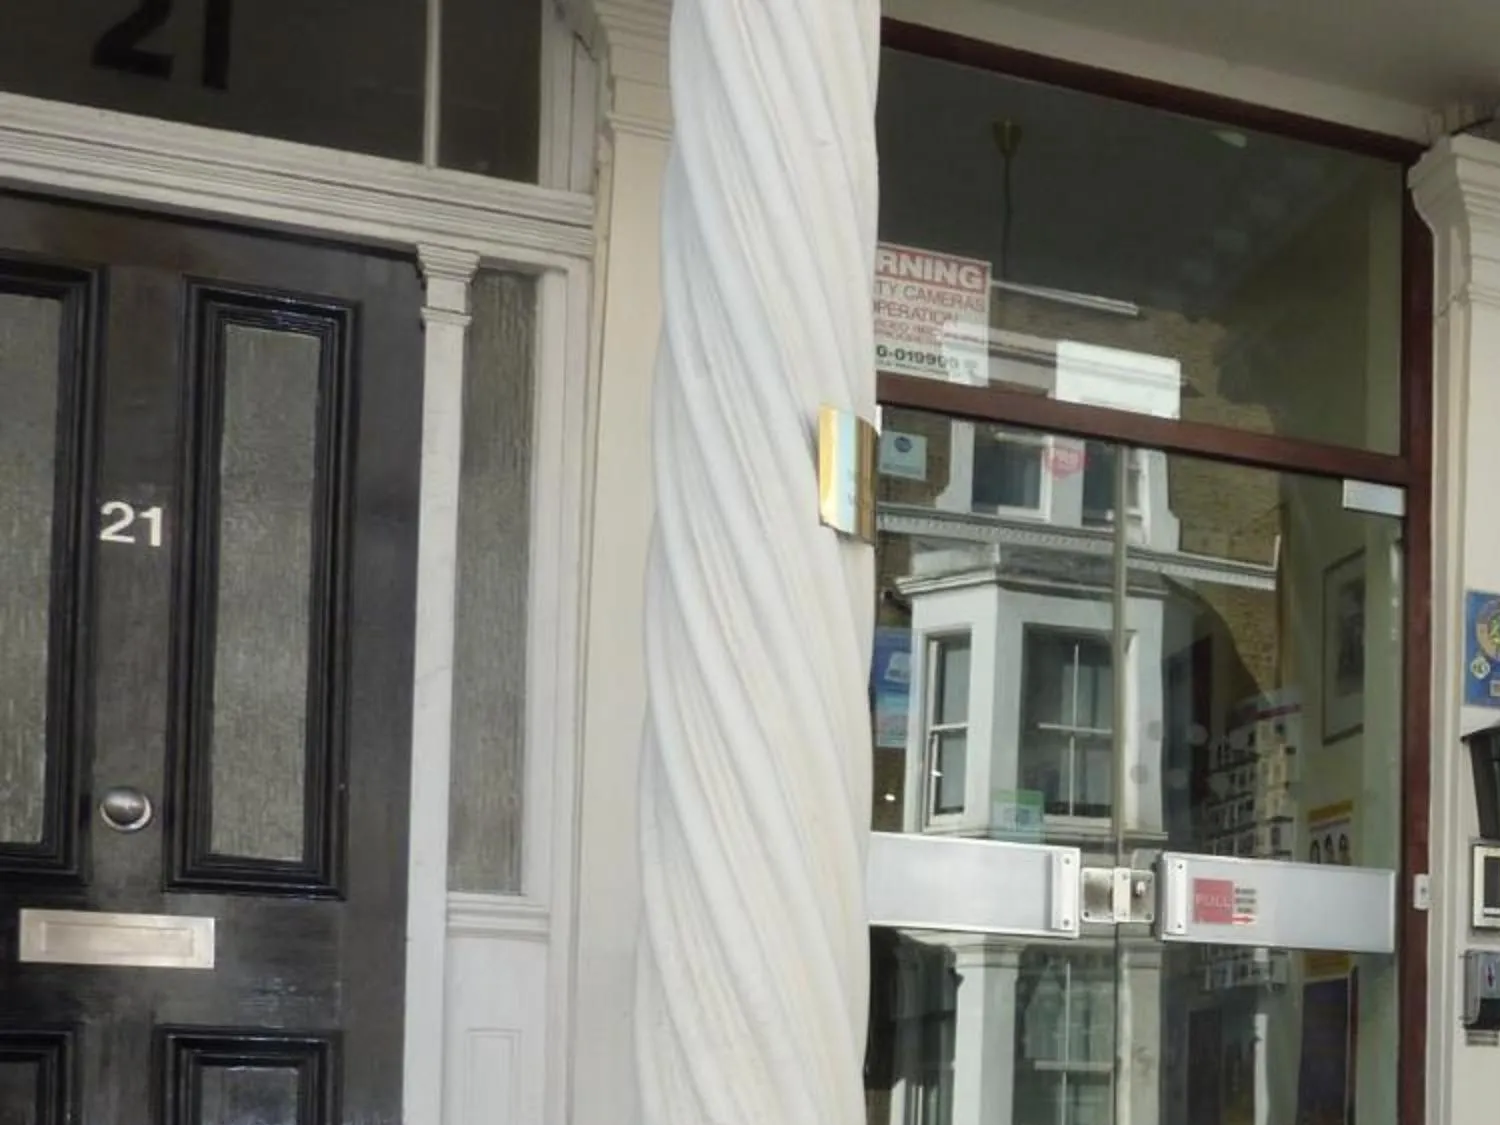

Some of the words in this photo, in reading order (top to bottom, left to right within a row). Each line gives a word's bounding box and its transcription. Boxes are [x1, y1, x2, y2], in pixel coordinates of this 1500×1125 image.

[877, 252, 982, 290] RNING
[873, 300, 959, 328] PERATION
[100, 501, 162, 547] 21
